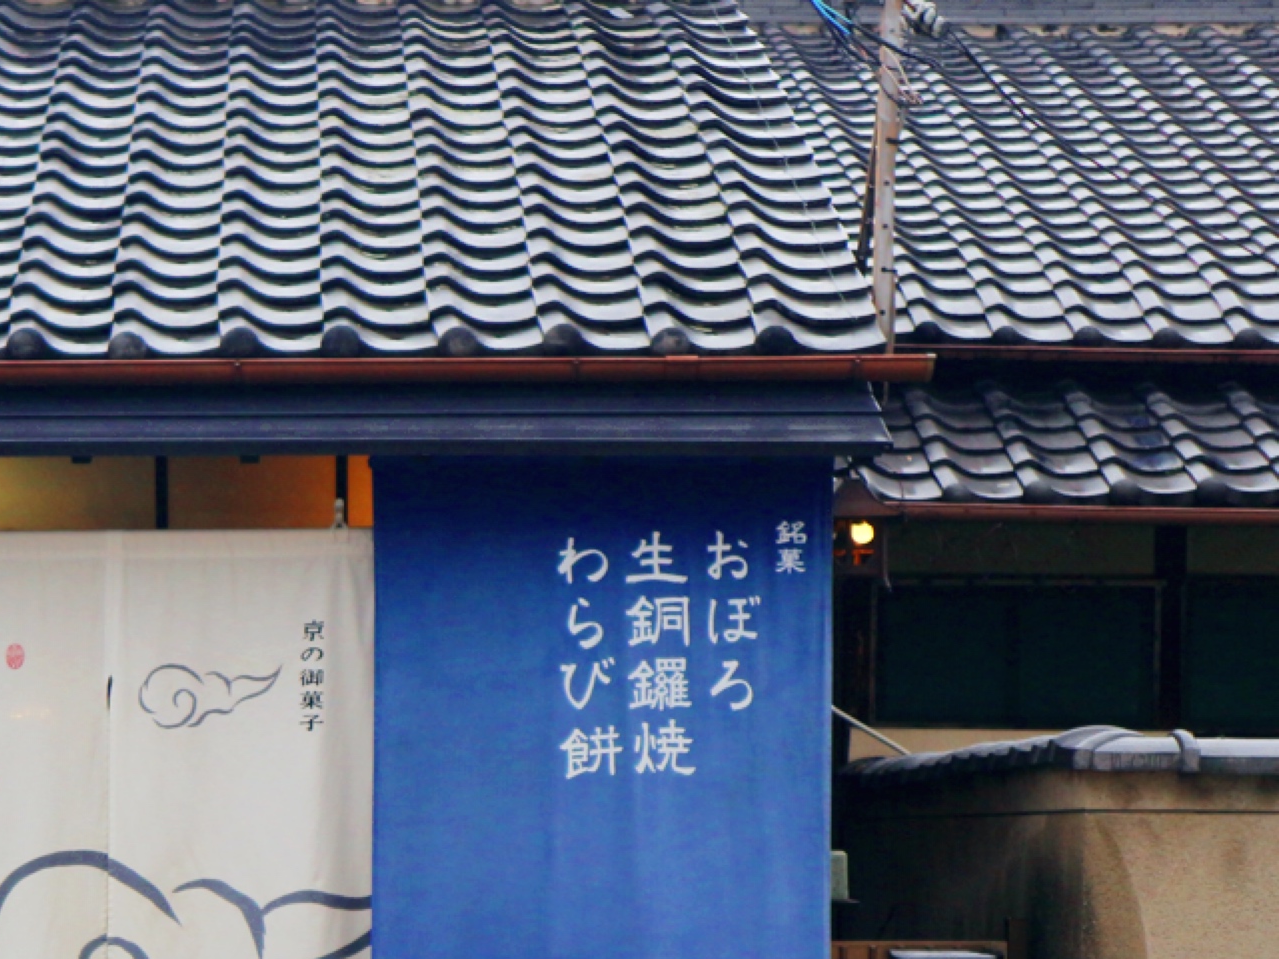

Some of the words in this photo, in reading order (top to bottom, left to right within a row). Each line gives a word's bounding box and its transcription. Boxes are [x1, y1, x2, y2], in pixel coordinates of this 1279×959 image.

[706, 530, 762, 711] おぼろ
[775, 520, 808, 574] 銘菓
[298, 619, 325, 732] 京の御菓子
[556, 536, 624, 780] わらび餅
[625, 531, 697, 777] 生銅鑼焼
